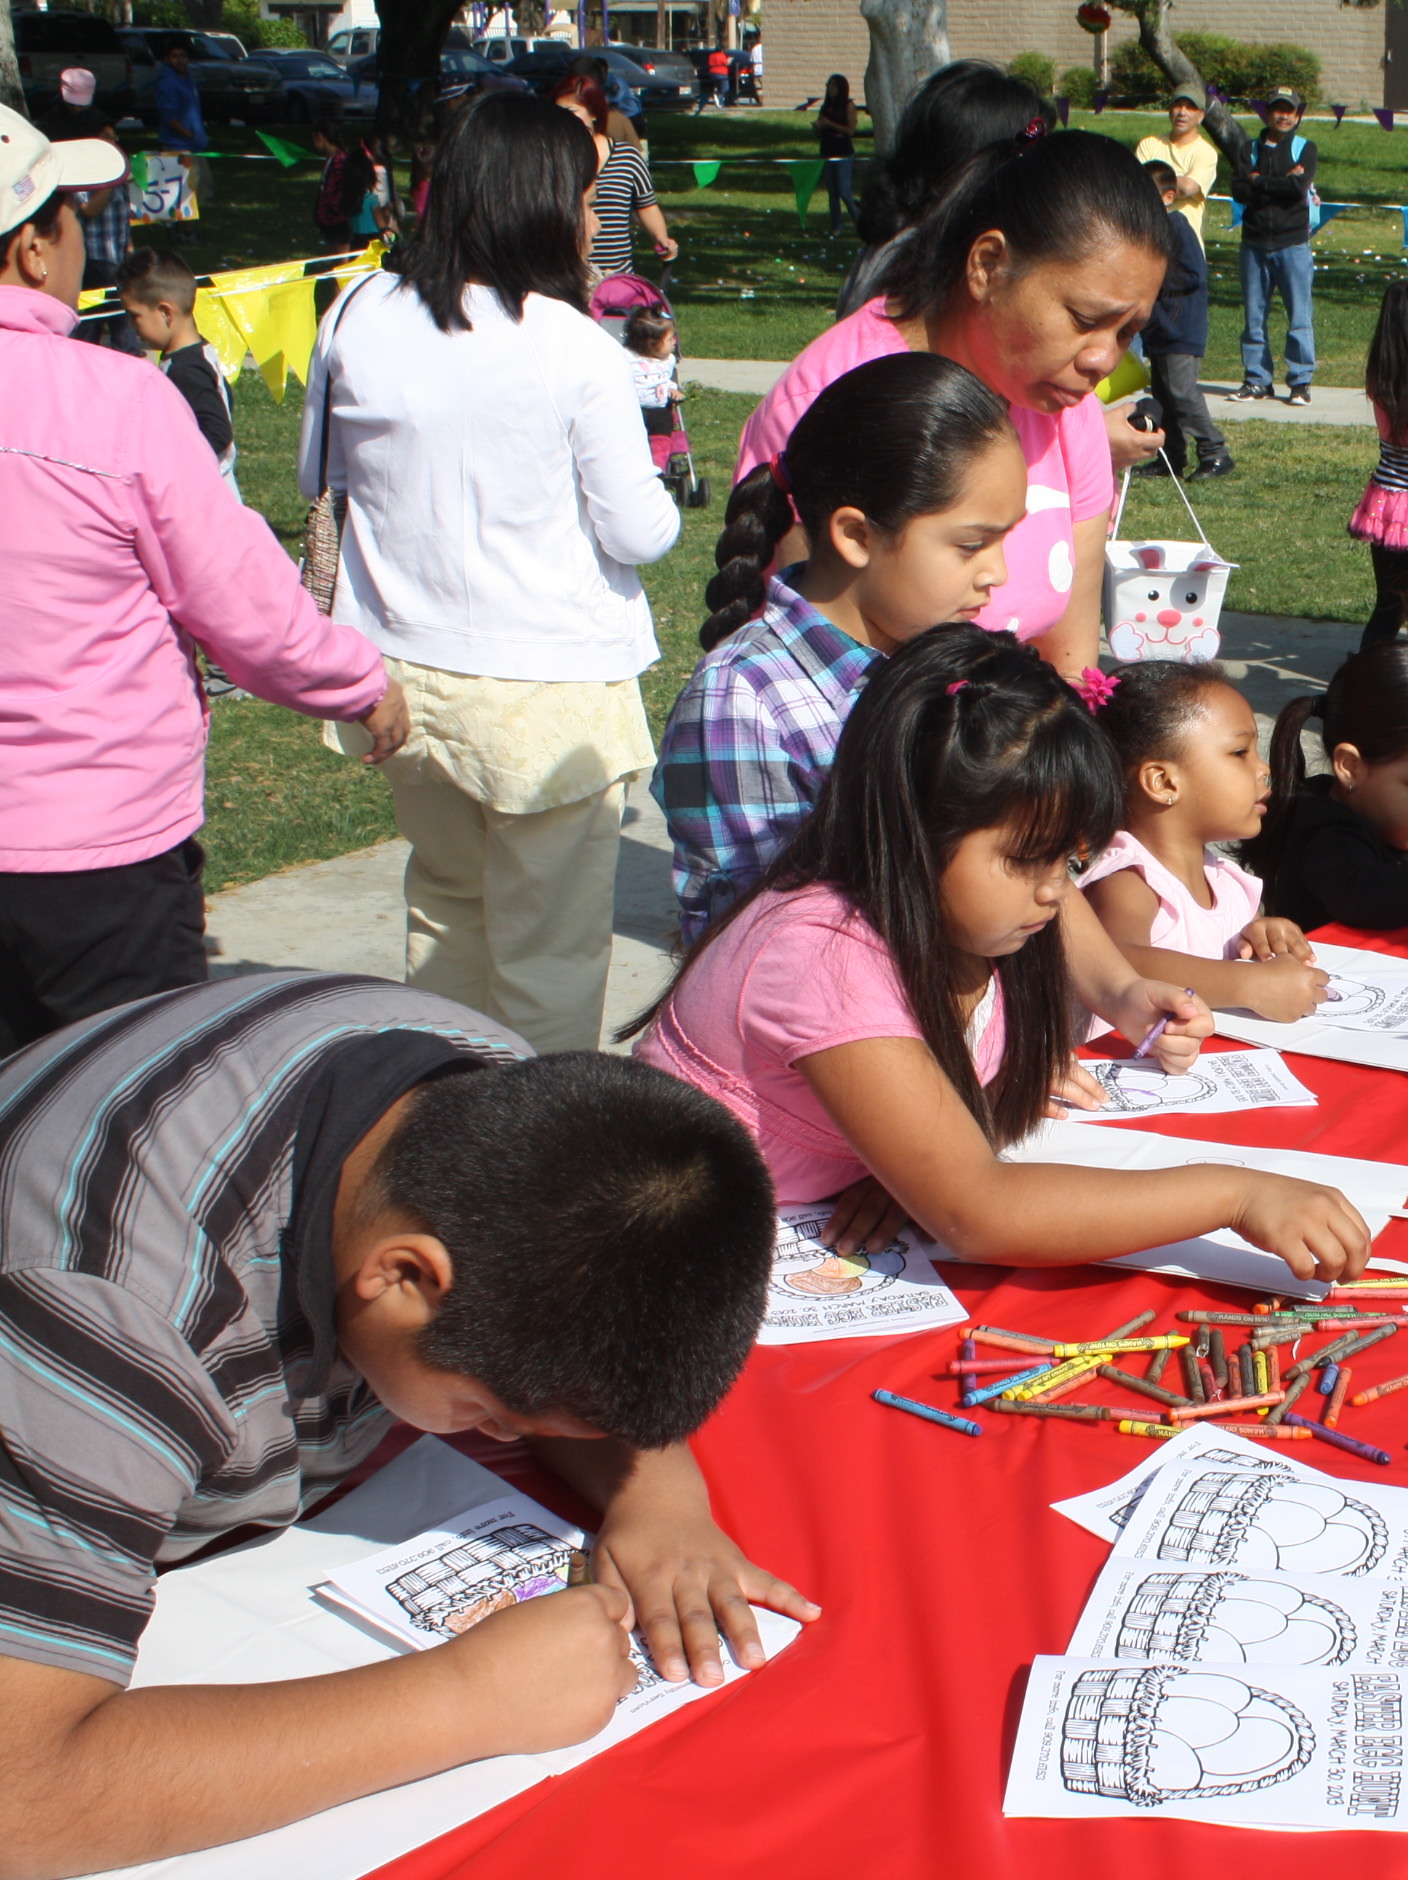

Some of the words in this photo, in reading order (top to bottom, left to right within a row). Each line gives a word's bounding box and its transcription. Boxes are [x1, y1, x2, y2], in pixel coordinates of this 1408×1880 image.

[1365, 1633, 1388, 1664] MARCH
[1350, 1674, 1403, 1732] EASTER
[1328, 1729, 1348, 1764] MARCH
[1353, 1735, 1403, 1768] EGG
[1326, 1785, 1345, 1806] 2013
[1347, 1771, 1402, 1817] HUNT
